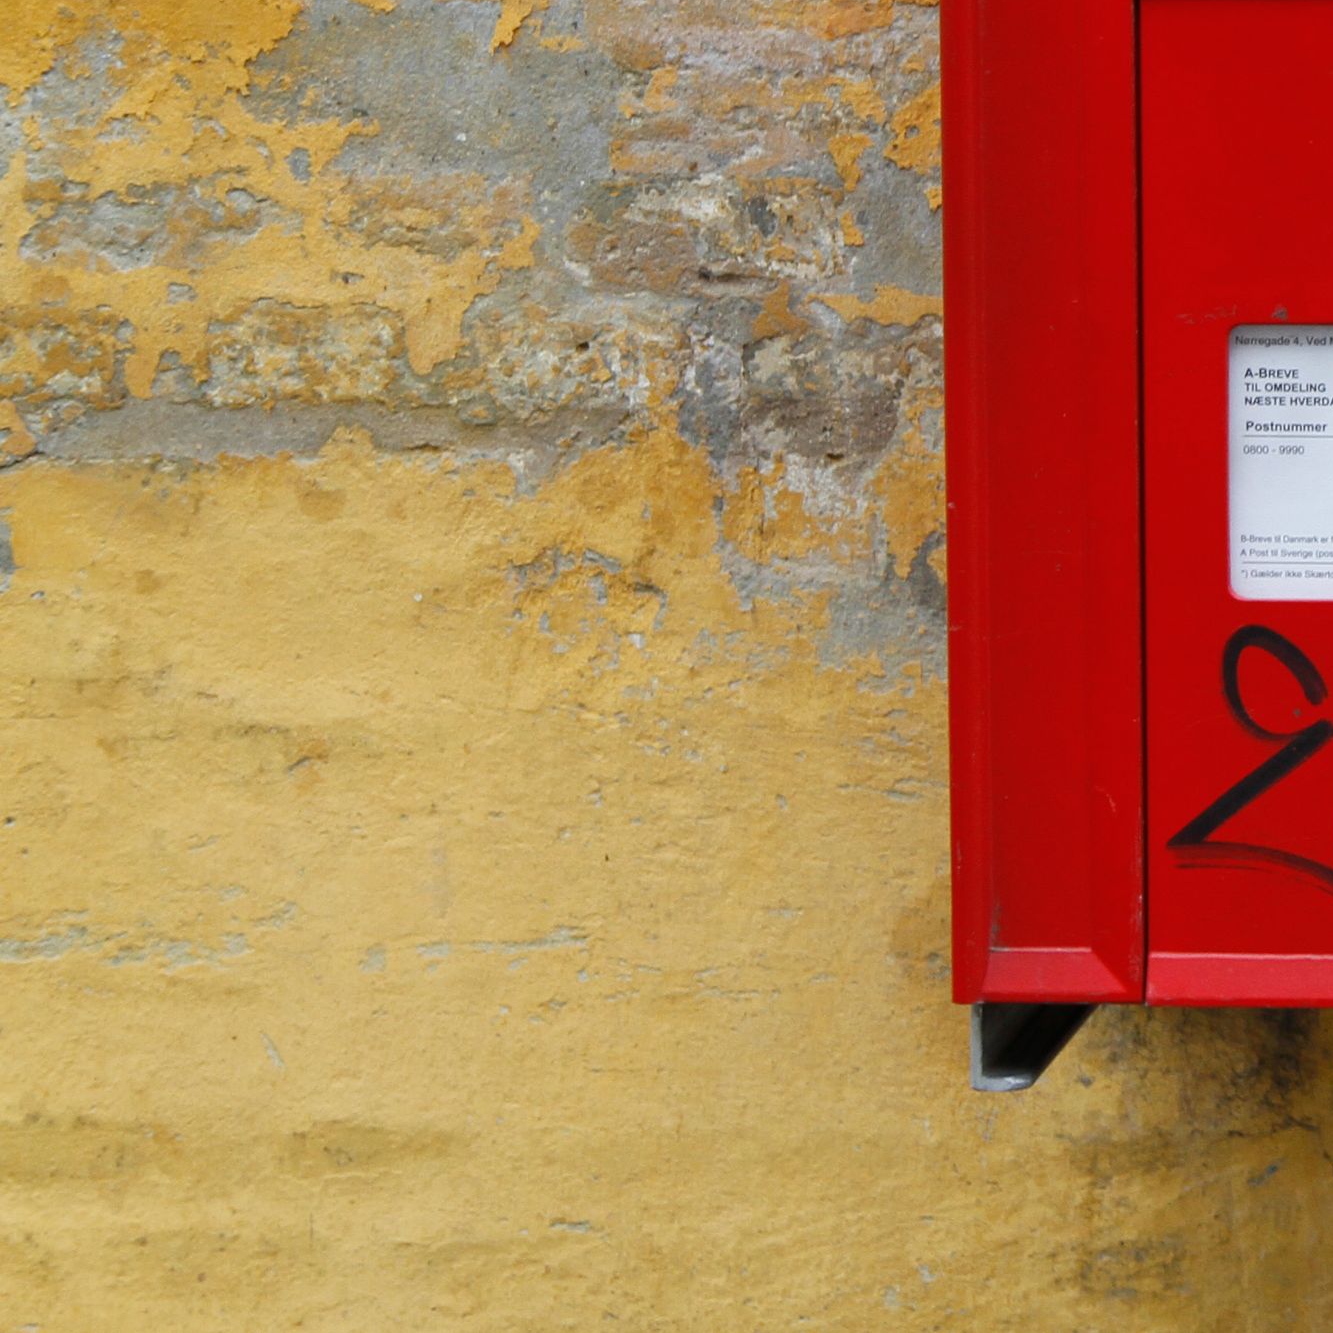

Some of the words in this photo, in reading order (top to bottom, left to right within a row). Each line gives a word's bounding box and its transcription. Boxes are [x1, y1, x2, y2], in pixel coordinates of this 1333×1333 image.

[1235, 336, 1290, 346] Nørregade
[1294, 336, 1302, 346] 4,
[1306, 337, 1327, 345] Ved
[1244, 369, 1299, 378] A-BREVE
[1245, 384, 1260, 392] TIL
[1265, 384, 1326, 392] OMDELING
[1245, 397, 1285, 406] NÆSTE
[1246, 421, 1327, 433] Postnummer
[1243, 446, 1269, 455] 0800
[1280, 446, 1304, 455] 9990
